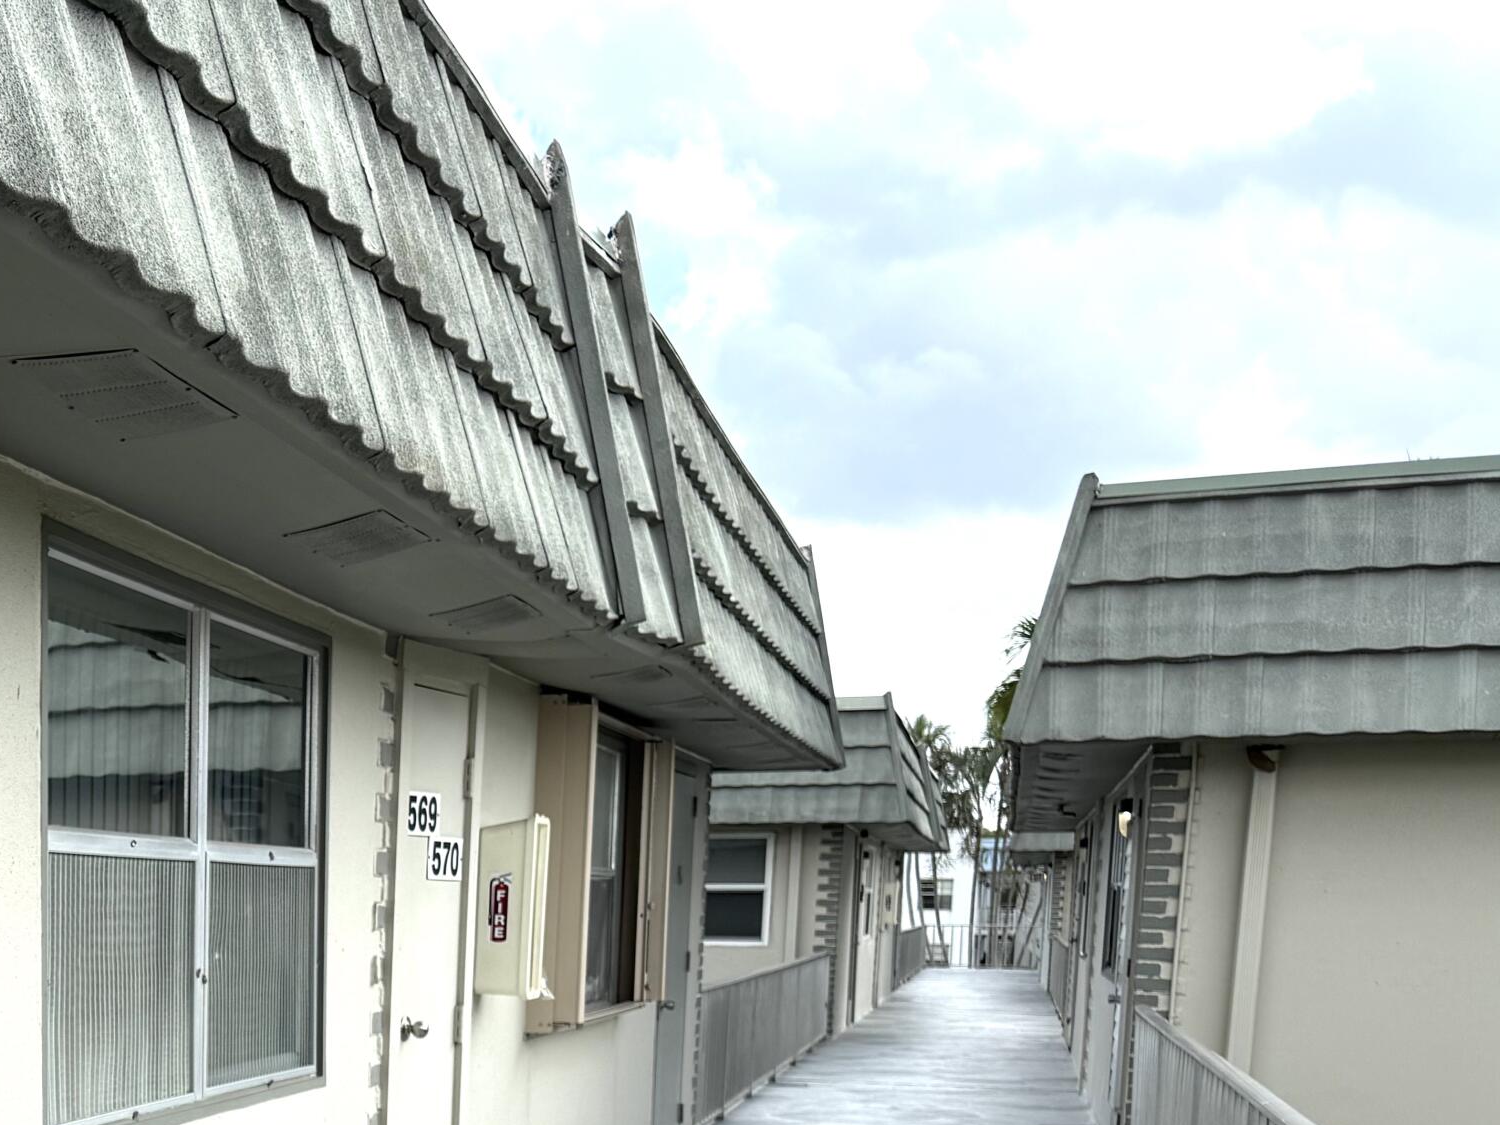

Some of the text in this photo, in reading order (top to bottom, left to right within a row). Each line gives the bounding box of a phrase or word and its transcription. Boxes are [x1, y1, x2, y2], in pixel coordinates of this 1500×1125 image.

[408, 795, 437, 832] 569
[432, 841, 459, 876] 570
[494, 890, 506, 938] FIRE
